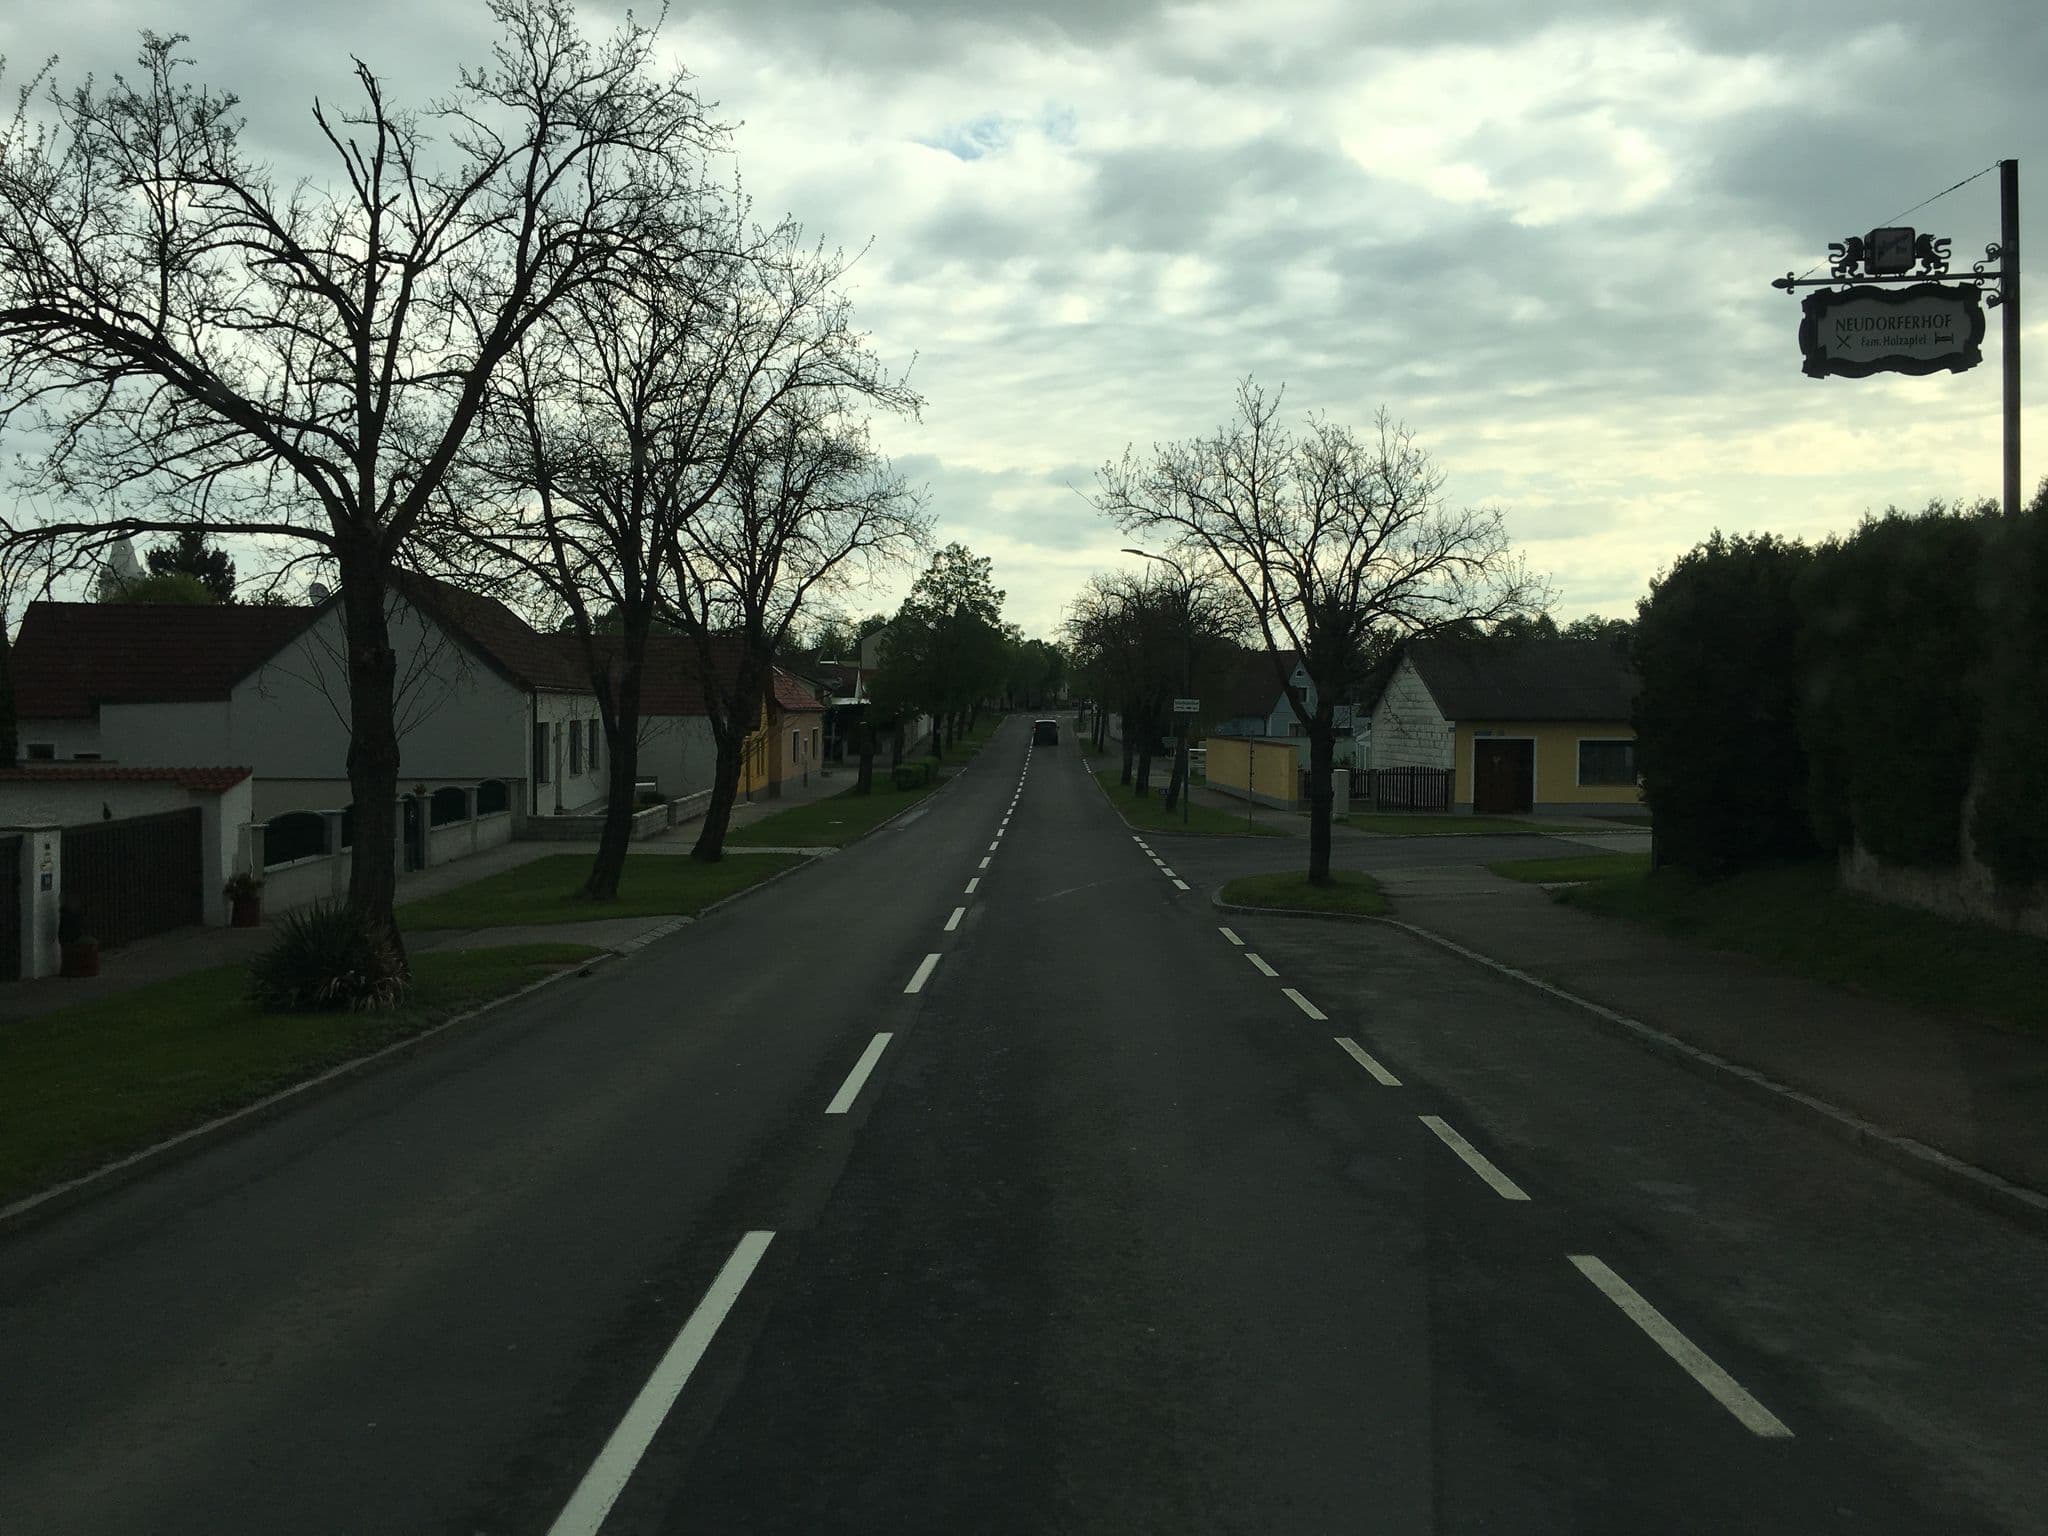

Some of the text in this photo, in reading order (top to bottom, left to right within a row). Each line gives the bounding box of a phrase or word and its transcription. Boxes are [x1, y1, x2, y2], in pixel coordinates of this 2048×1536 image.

[1835, 314, 1953, 332] NEUDORFERHOF
[1861, 335, 1927, 349] Fam. Holzapfel
